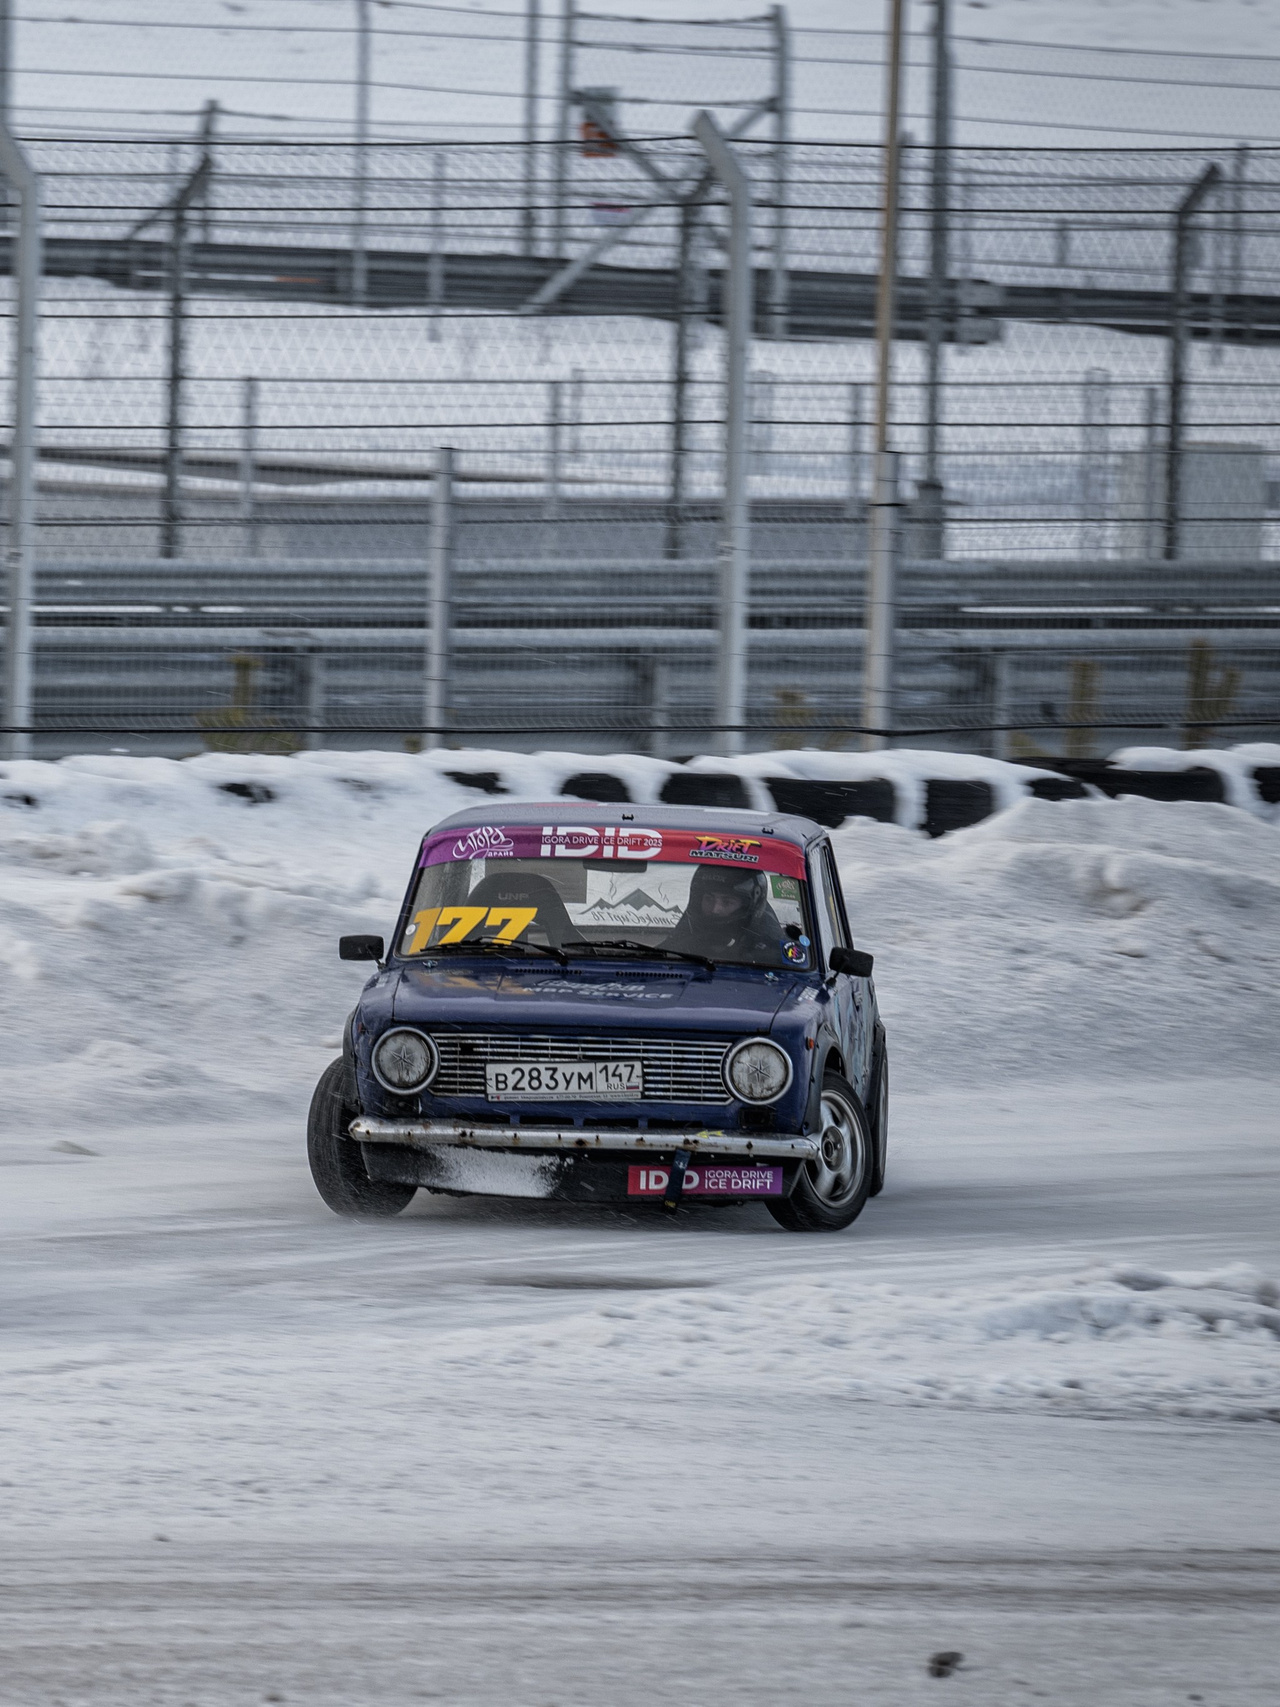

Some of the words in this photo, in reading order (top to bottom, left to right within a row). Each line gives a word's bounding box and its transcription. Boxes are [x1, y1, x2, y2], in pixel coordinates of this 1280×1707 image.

[540, 826, 663, 859] IDID
[541, 835, 571, 844] IGORA
[572, 835, 599, 845] DRIVE
[601, 837, 615, 845] ICE
[617, 837, 641, 846] DRIFT
[643, 838, 663, 847] 2025
[689, 849, 759, 863] MATSURI
[408, 907, 538, 955] 177
[494, 1066, 594, 1091] В283УМ
[598, 1064, 635, 1083] 147
[606, 1082, 625, 1090] RUS
[640, 1170, 700, 1190] IDD
[704, 1170, 739, 1179] IGORA
[741, 1170, 773, 1180] DRIVE
[704, 1178, 727, 1190] ICE
[731, 1178, 773, 1191] DRIFT
